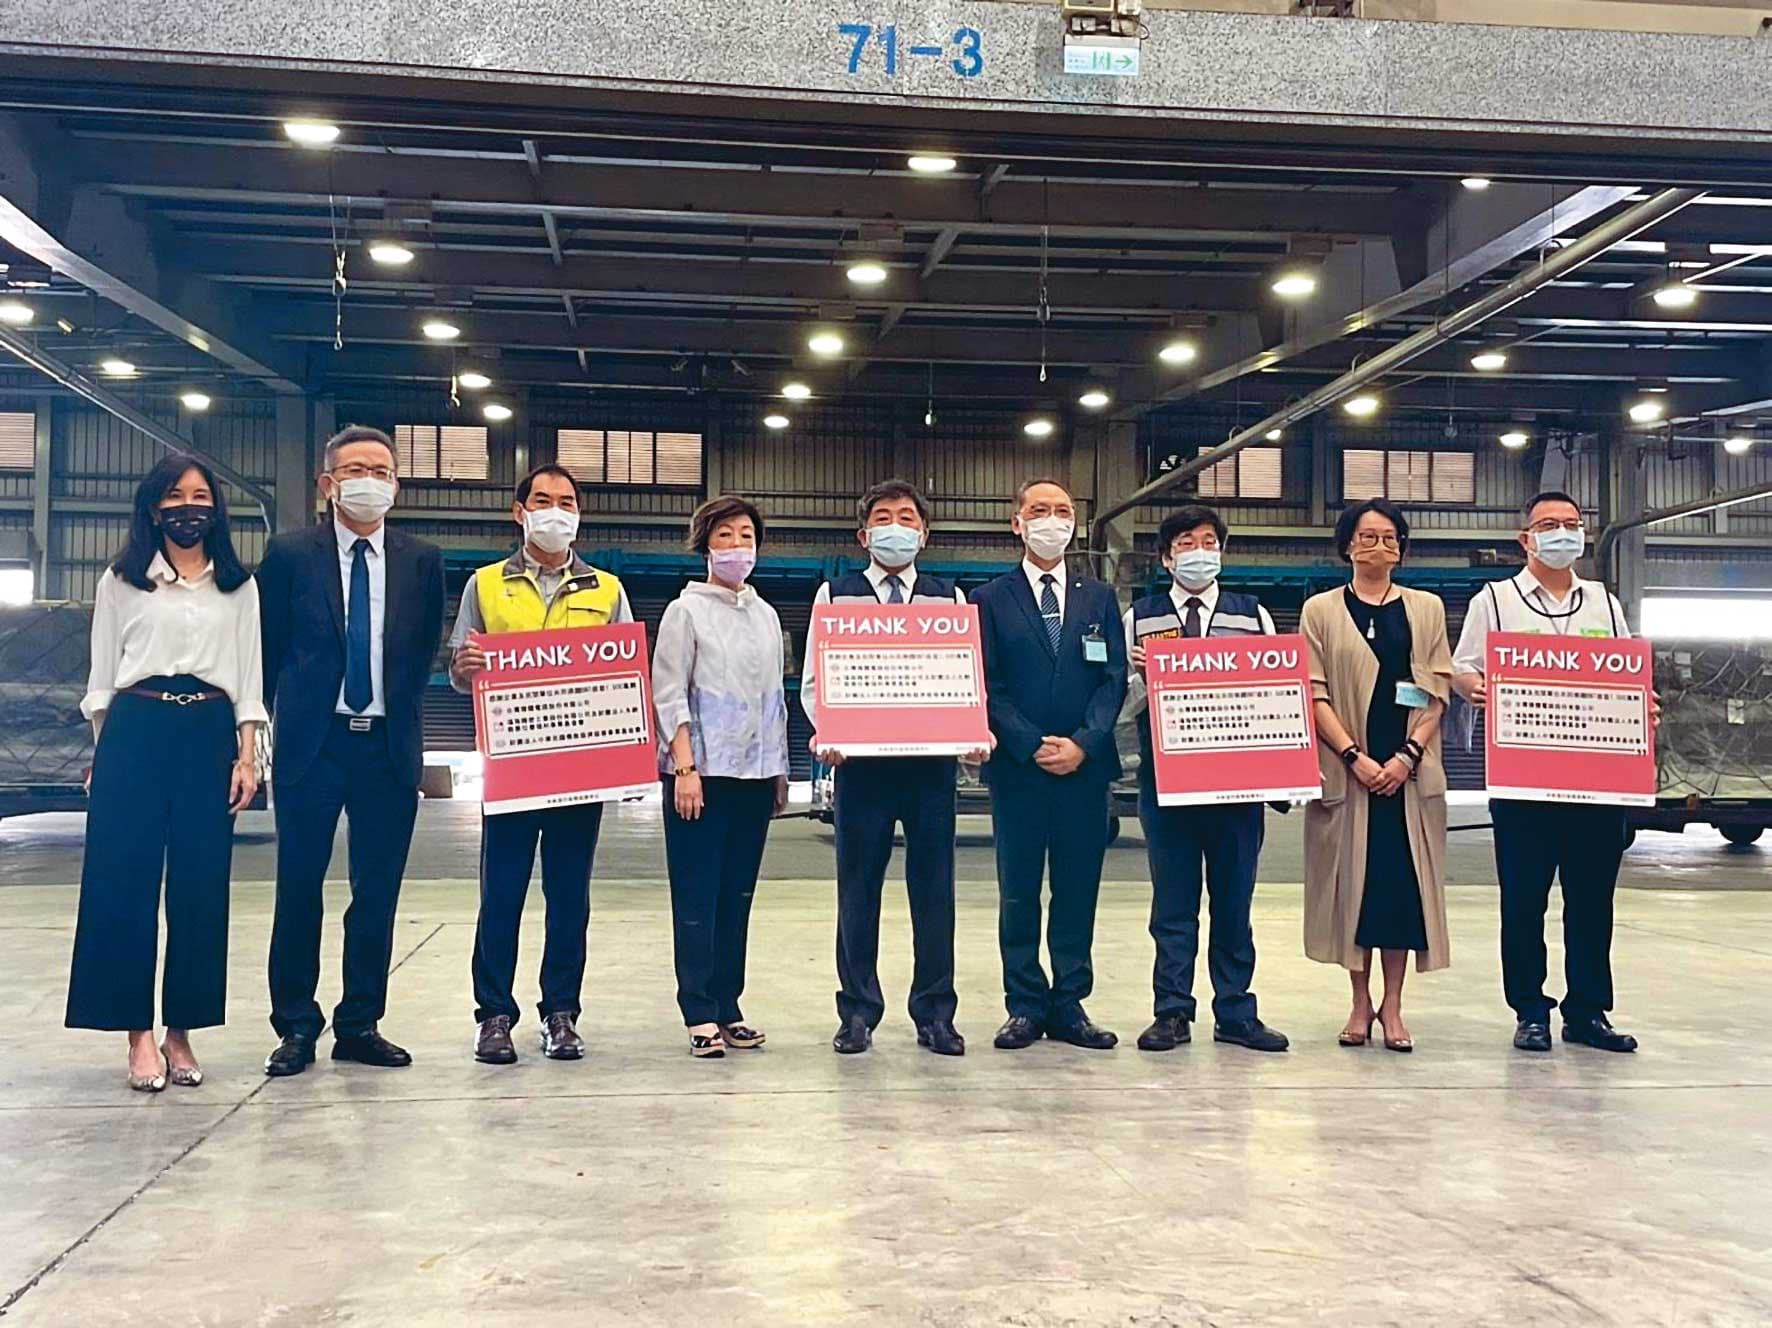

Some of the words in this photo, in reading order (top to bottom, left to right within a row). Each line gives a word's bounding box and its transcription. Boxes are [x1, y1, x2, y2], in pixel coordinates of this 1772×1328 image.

[837, 24, 983, 77] 71-3
[821, 617, 908, 634] THANK
[917, 617, 969, 634] YOU
[484, 645, 572, 671] THANK
[582, 640, 637, 662] YOU
[1153, 651, 1238, 672] THANK
[1247, 650, 1298, 670] YOU
[1494, 647, 1580, 671] THANK
[1590, 652, 1643, 673] YOU
